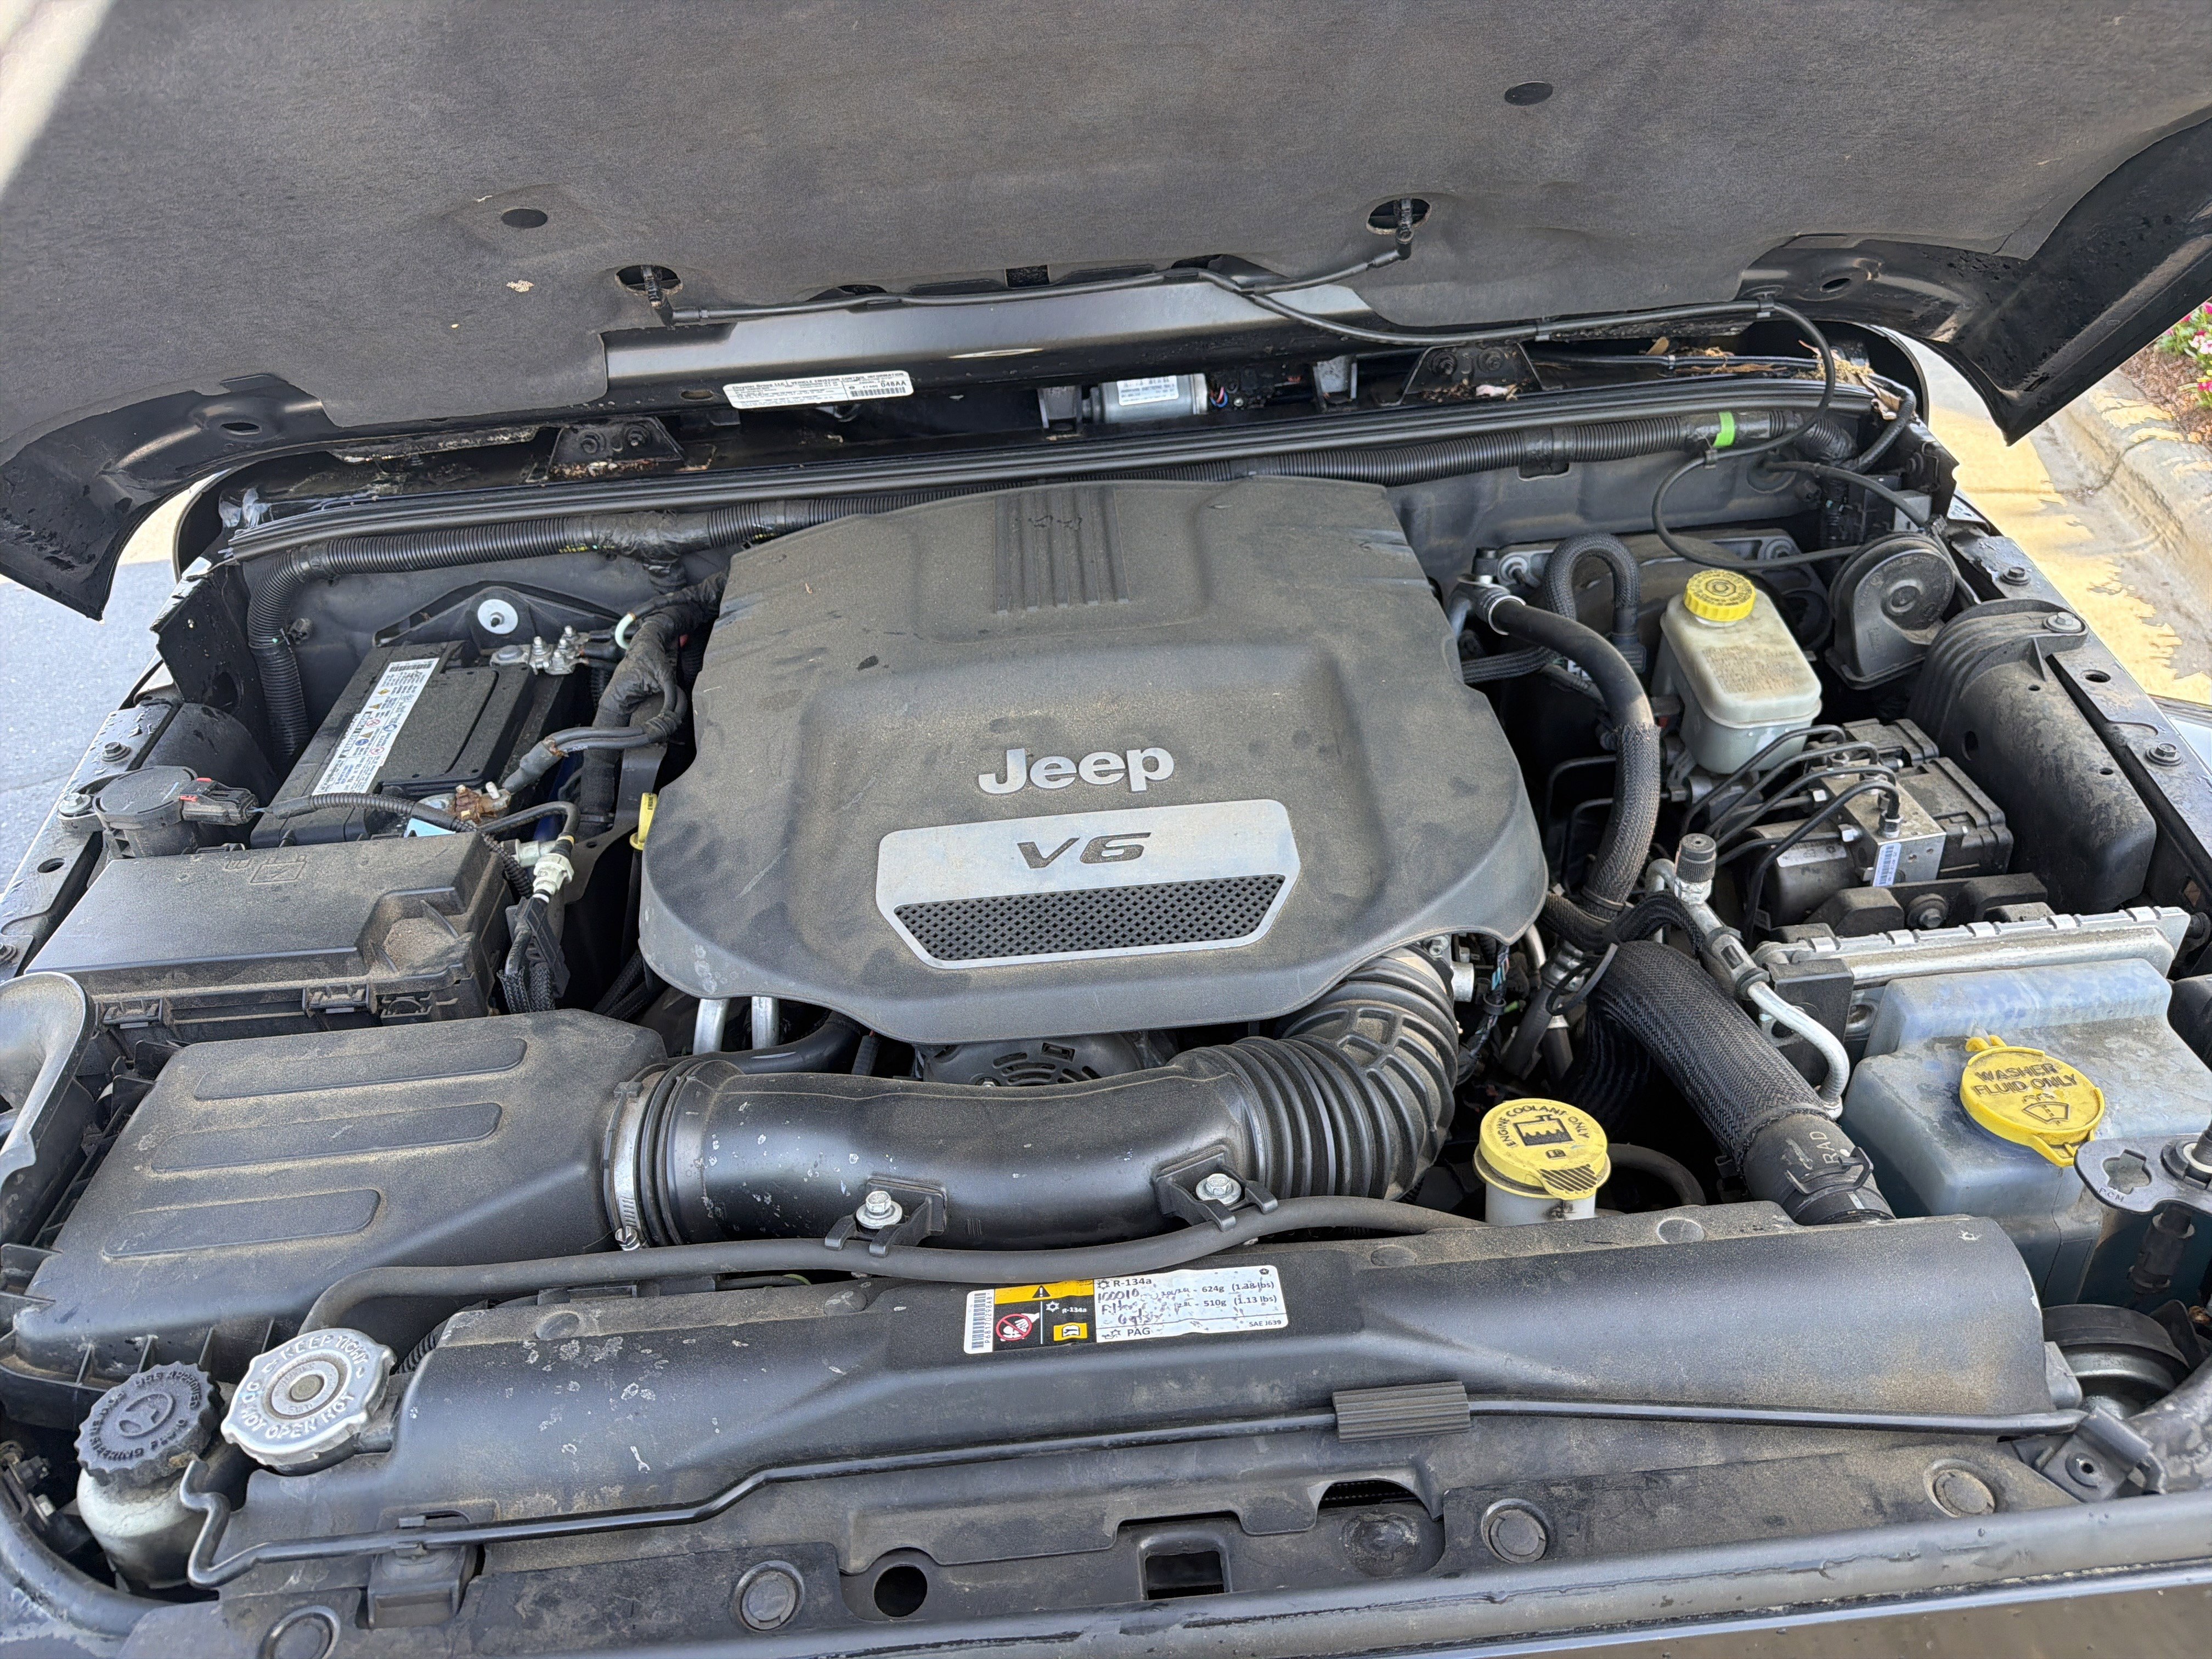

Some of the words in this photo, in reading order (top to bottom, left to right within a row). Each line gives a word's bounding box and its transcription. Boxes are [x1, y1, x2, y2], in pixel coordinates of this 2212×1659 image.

[978, 747, 1175, 794] Jeep
[1017, 832, 1152, 869] V6
[1973, 1080, 2028, 1096] FLUID
[2030, 1074, 2078, 1089] ONLY
[1976, 1063, 2058, 1081] WASHER
[1505, 1105, 1568, 1118] COOLANT
[1496, 1117, 1517, 1147] ENGINE
[1568, 1116, 1590, 1139] ONLY
[1809, 1131, 1842, 1164] RAD
[1113, 1278, 1152, 1288] R-134a
[1234, 1297, 1257, 1306] (1.13
[1260, 1295, 1278, 1304] lbs)
[984, 1296, 992, 1344] P68170298AB
[1127, 1327, 1151, 1336] PAG
[280, 1334, 334, 1360] KEEP
[335, 1335, 371, 1364] TIGHT
[167, 1370, 202, 1410] APPROVED
[241, 1409, 268, 1431] NOT
[264, 1419, 317, 1440] OPEN
[320, 1394, 355, 1423] HOT
